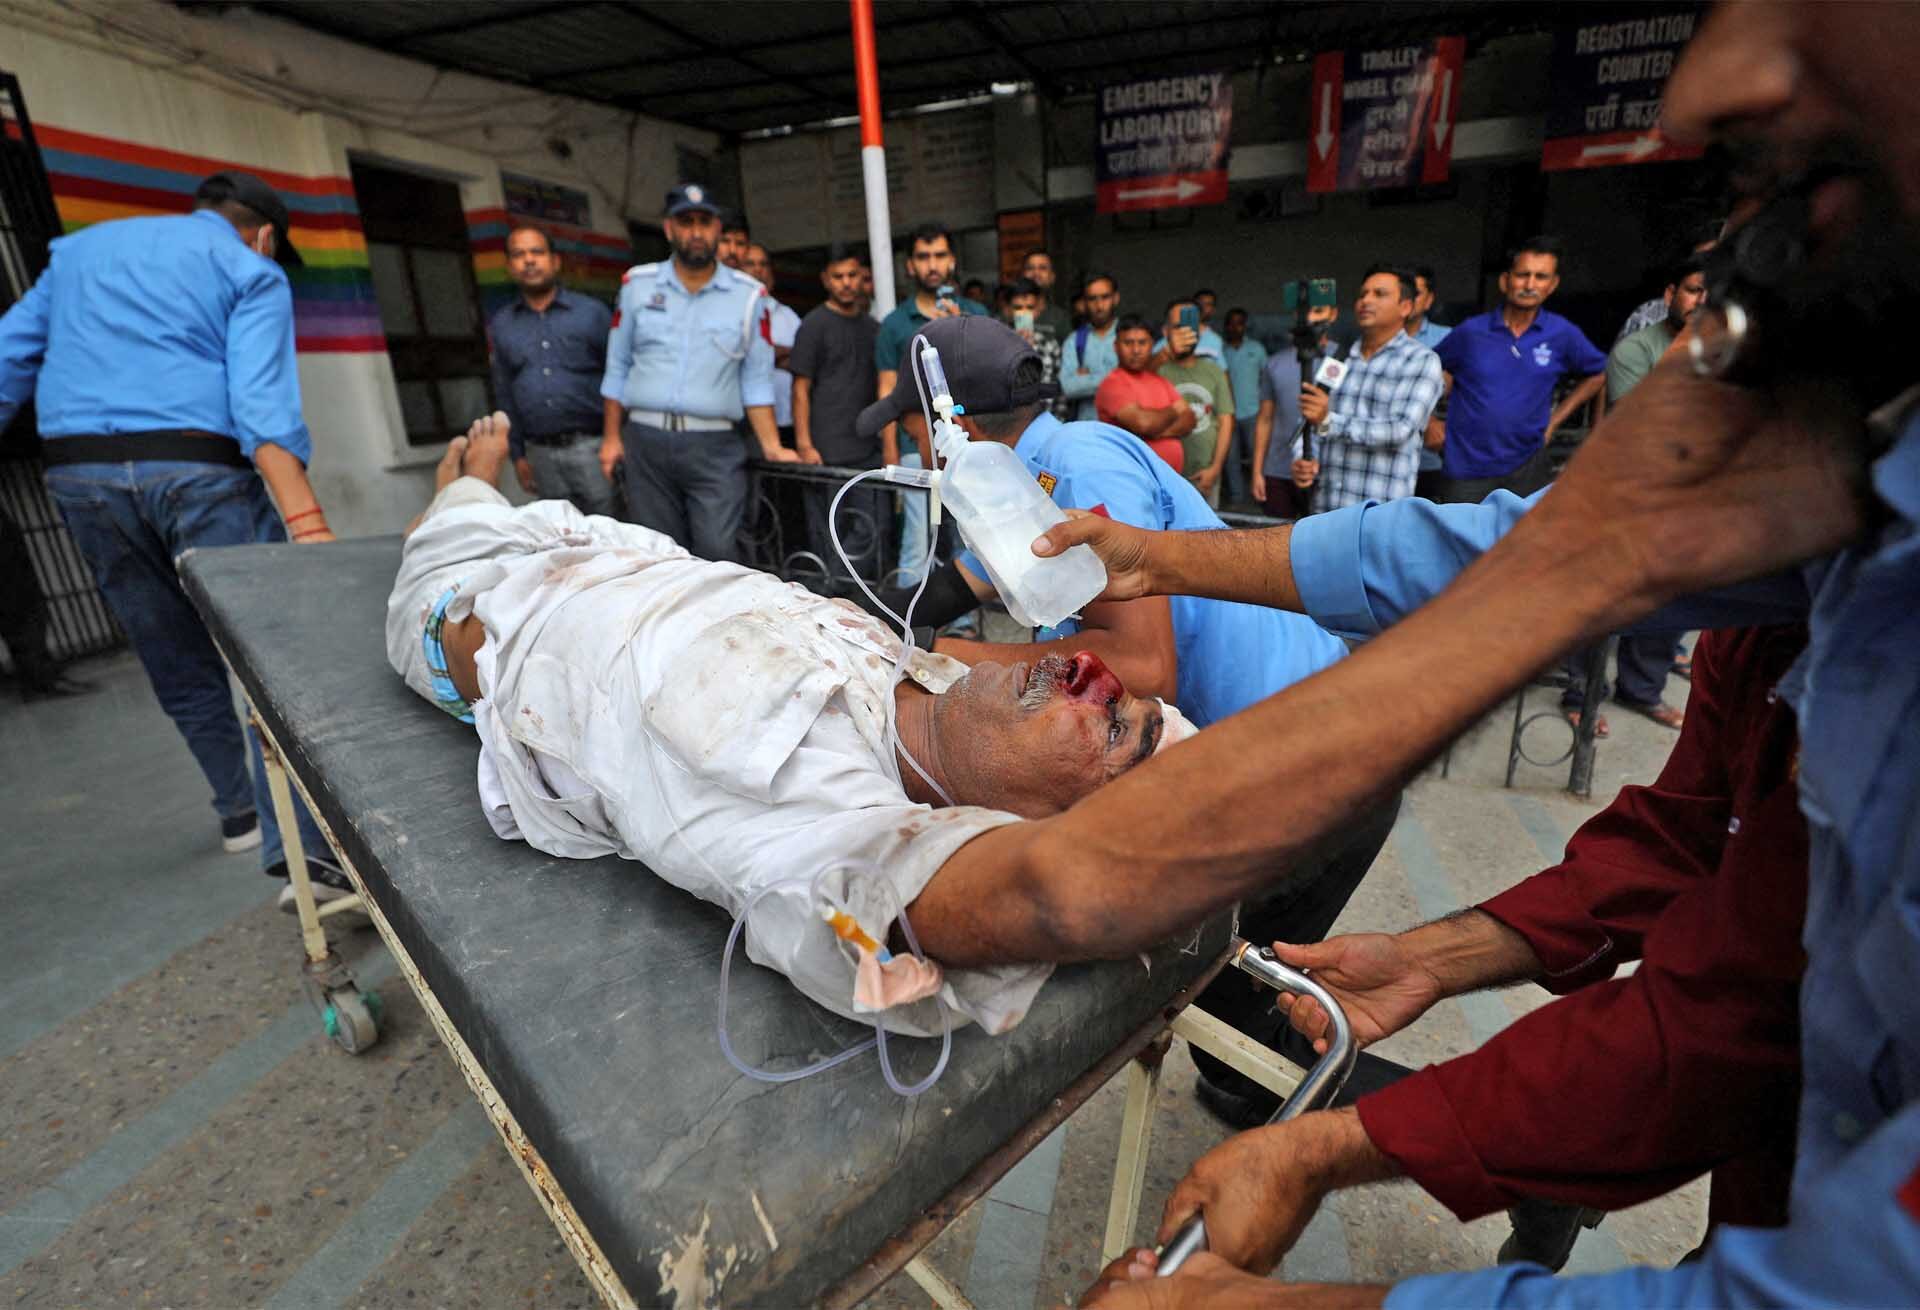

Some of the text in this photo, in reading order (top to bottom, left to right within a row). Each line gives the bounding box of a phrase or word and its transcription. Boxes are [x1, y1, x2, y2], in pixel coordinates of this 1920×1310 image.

[1576, 14, 1696, 54] REGISTRATION
[1597, 51, 1673, 85] COUNTER
[1103, 73, 1223, 114] EMERGENCY
[1100, 108, 1222, 145] LABORATORY
